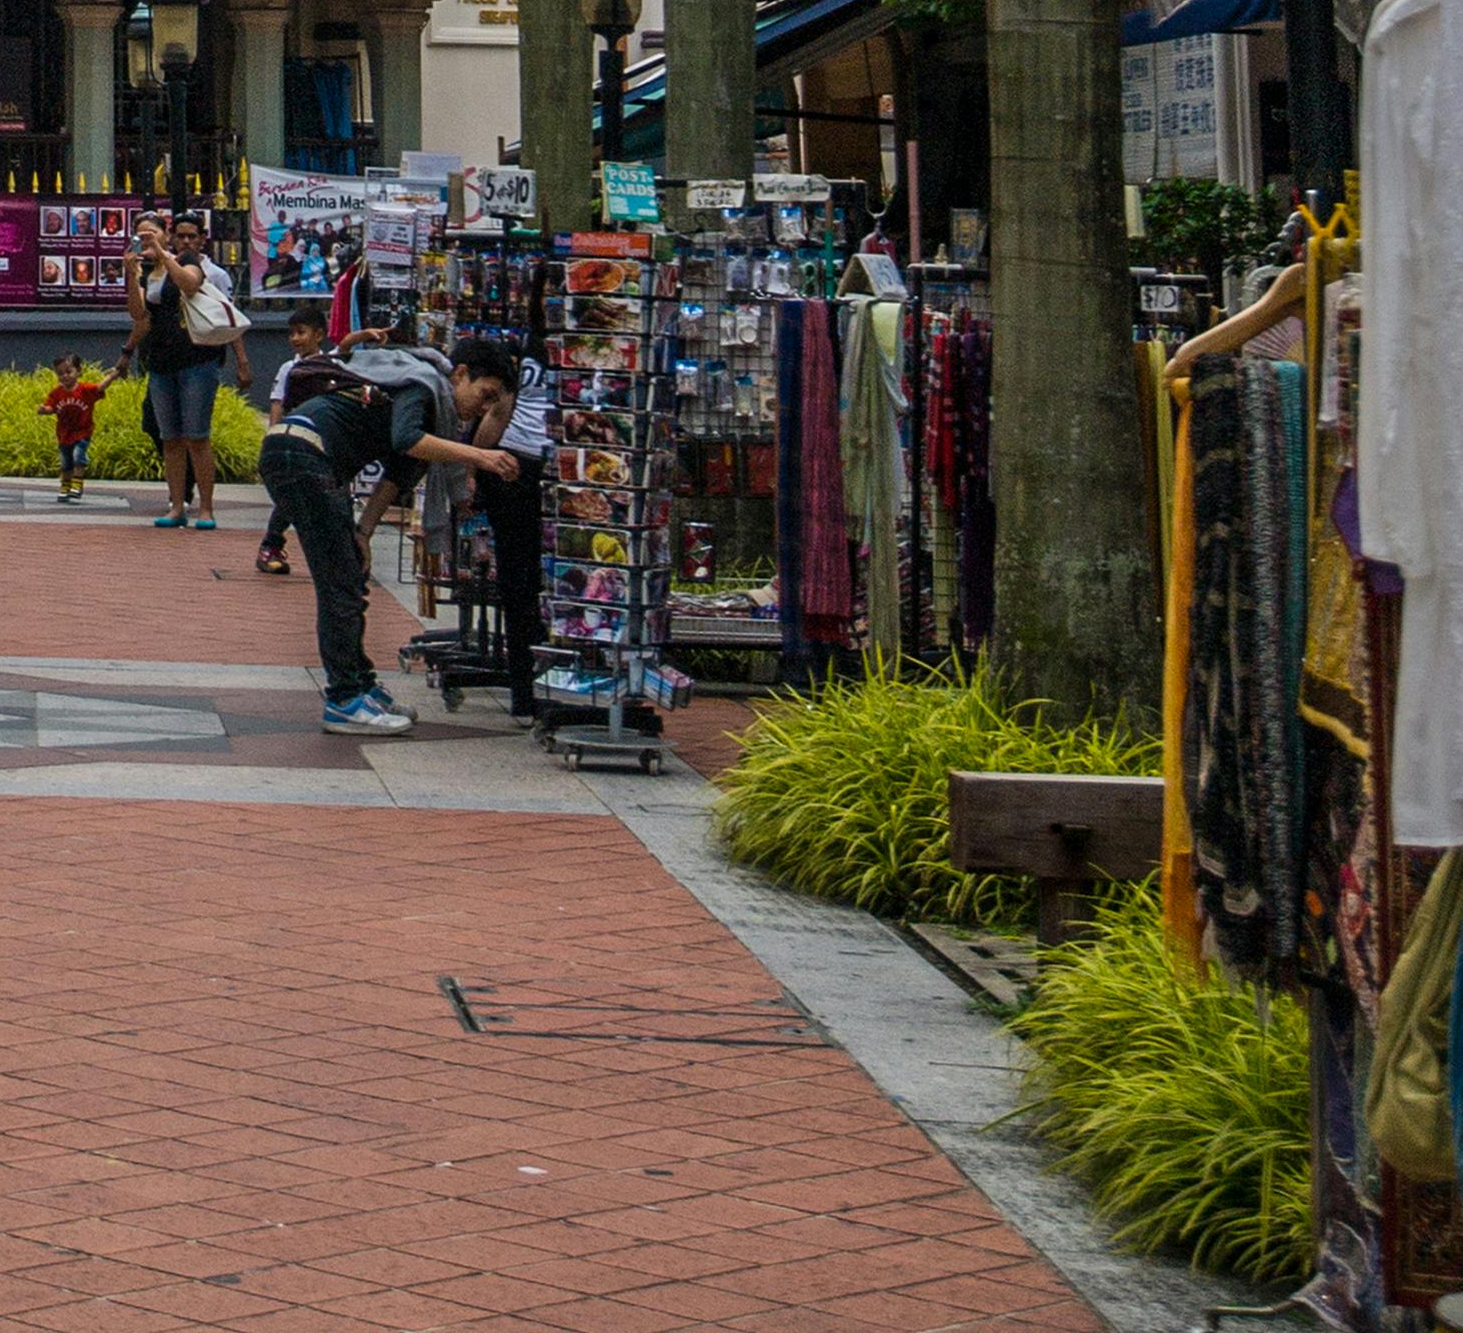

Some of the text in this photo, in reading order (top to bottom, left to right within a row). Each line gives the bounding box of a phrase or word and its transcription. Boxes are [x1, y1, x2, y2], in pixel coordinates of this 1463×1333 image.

[606, 181, 657, 197] CARDS
[273, 192, 337, 210] Membina
[1144, 286, 1178, 309] $10
